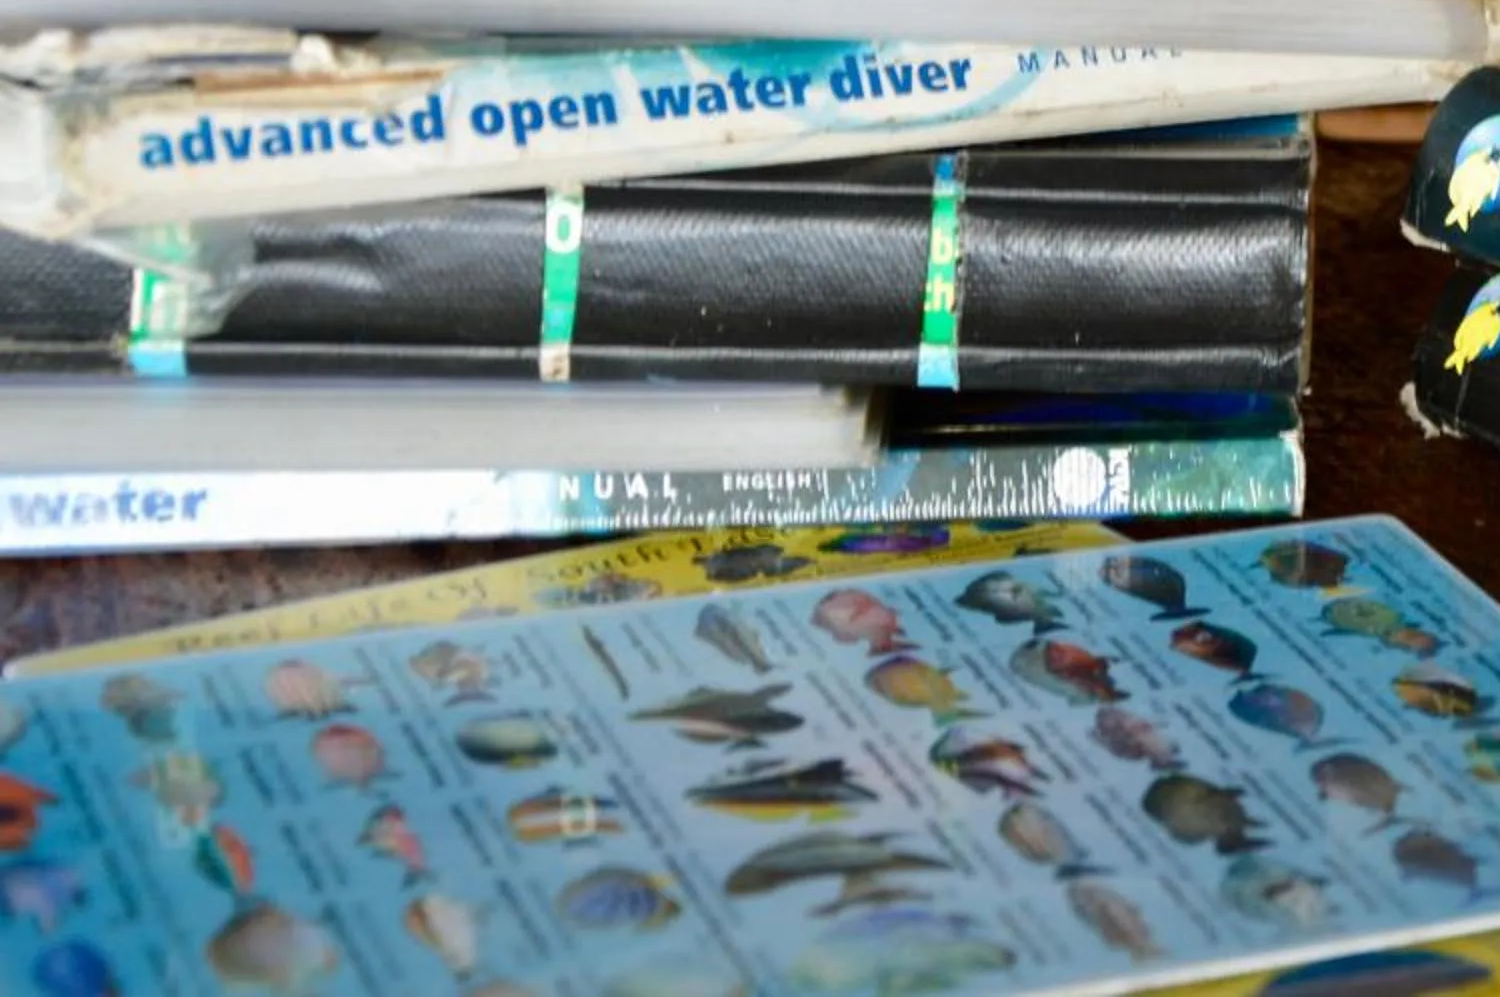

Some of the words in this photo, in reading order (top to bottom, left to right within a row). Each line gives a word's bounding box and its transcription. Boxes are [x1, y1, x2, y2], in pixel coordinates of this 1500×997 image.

[139, 95, 446, 170] advanced
[470, 88, 619, 147] open
[639, 66, 813, 121] water
[828, 54, 972, 102] diver
[8, 478, 208, 528] water
